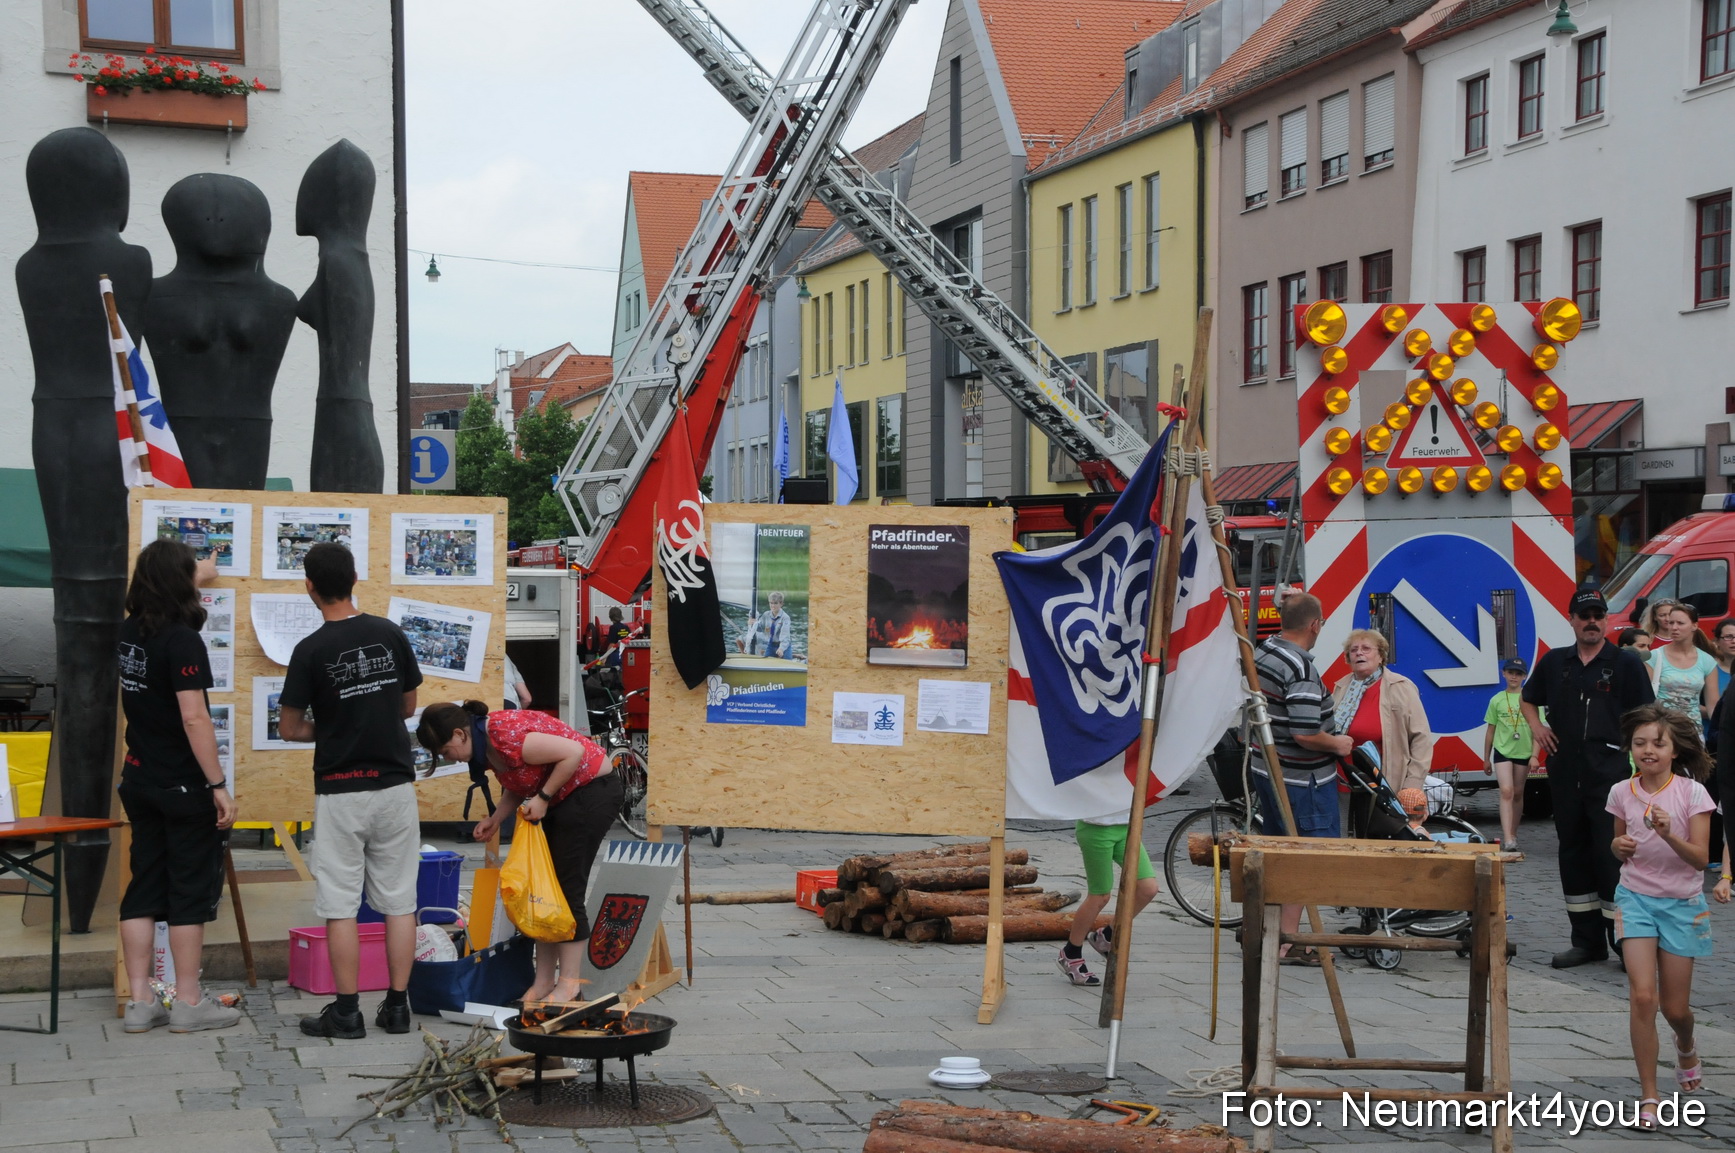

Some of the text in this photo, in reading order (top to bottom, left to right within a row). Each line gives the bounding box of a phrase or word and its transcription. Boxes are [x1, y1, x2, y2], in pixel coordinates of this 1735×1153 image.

[1412, 447, 1460, 456] Feuerwehr
[1641, 460, 1674, 470] GARDINEN
[757, 528, 804, 537] ABENTEUER
[871, 530, 956, 543] Pfadfinder.
[902, 543, 939, 551] Abenteuer
[732, 682, 784, 695] Pfadfinden
